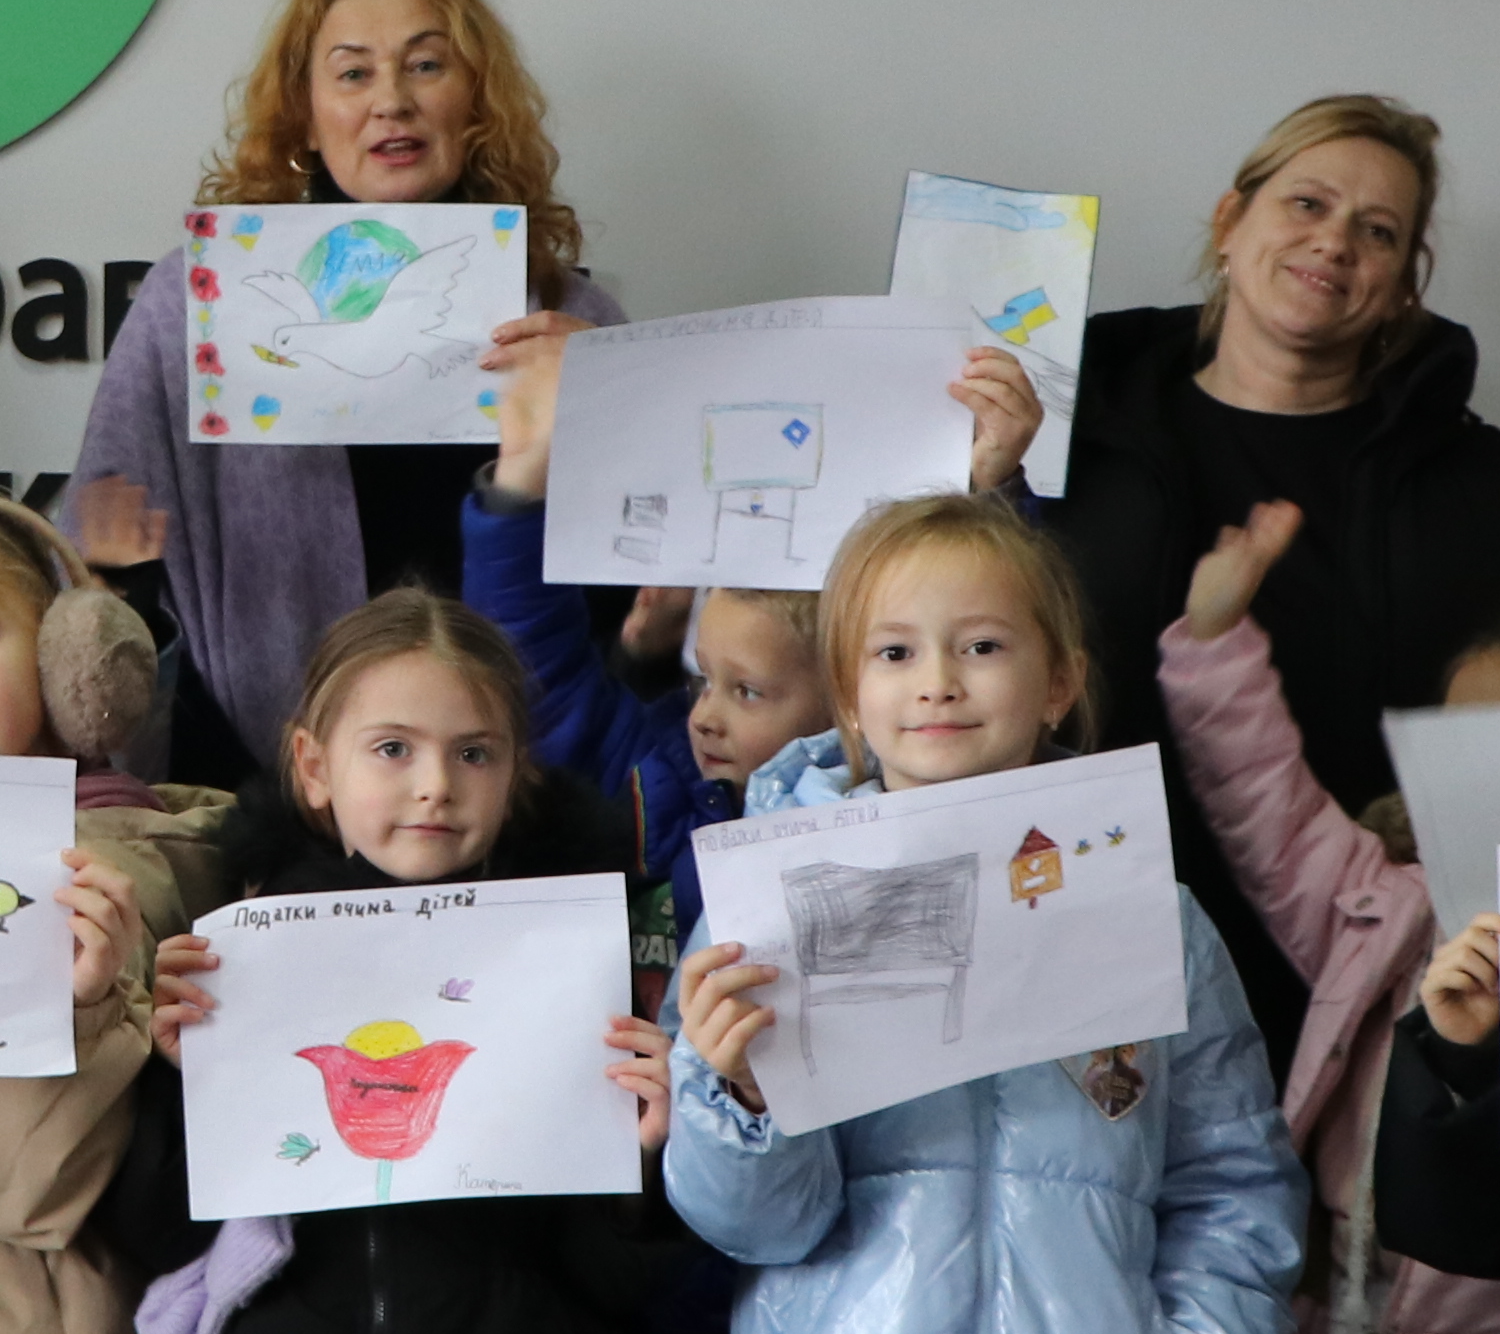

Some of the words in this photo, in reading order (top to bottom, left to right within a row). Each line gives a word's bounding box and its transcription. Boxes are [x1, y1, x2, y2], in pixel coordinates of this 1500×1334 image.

[233, 903, 316, 930] Податки
[332, 897, 397, 919] очима
[414, 887, 479, 918] дітей
